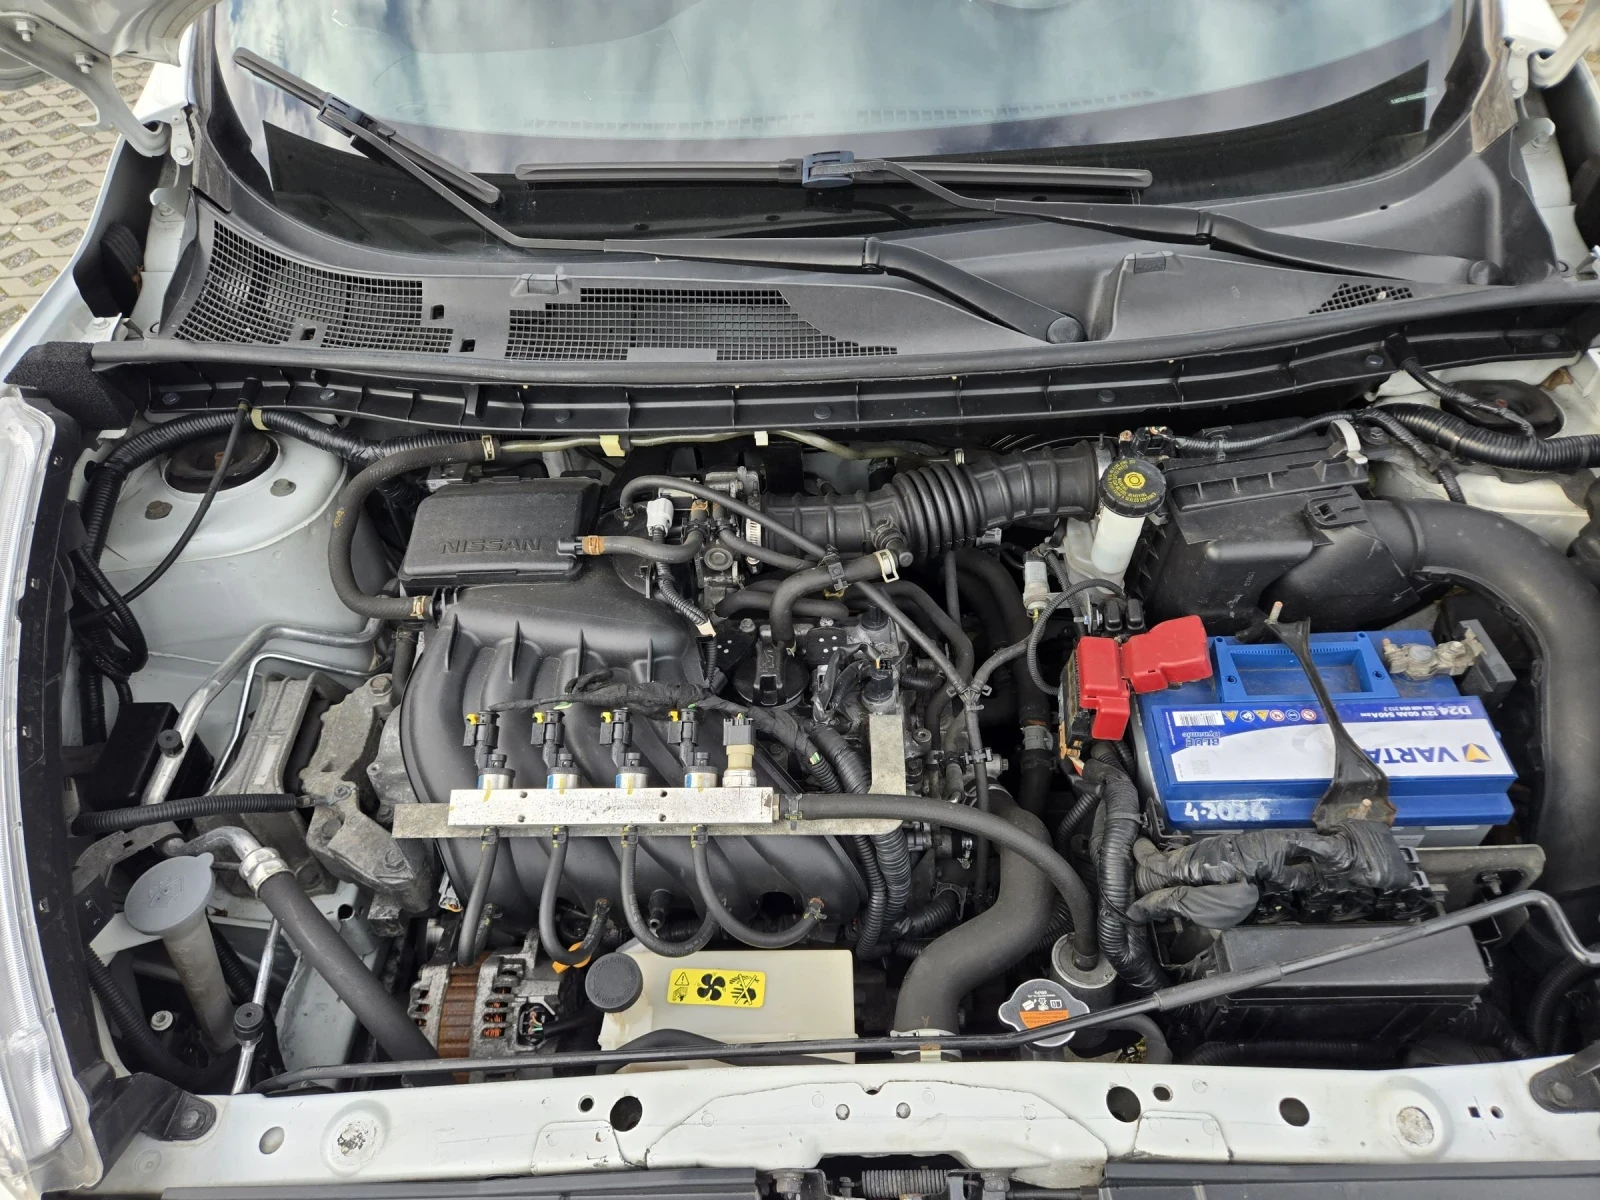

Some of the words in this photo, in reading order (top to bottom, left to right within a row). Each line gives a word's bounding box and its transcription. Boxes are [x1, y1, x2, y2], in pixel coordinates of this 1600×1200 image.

[439, 538, 541, 554] NISSAN
[1437, 705, 1472, 715] D24
[1182, 730, 1220, 738] Dynamic
[1186, 738, 1219, 747] BLUE
[1361, 747, 1459, 764] VARTA
